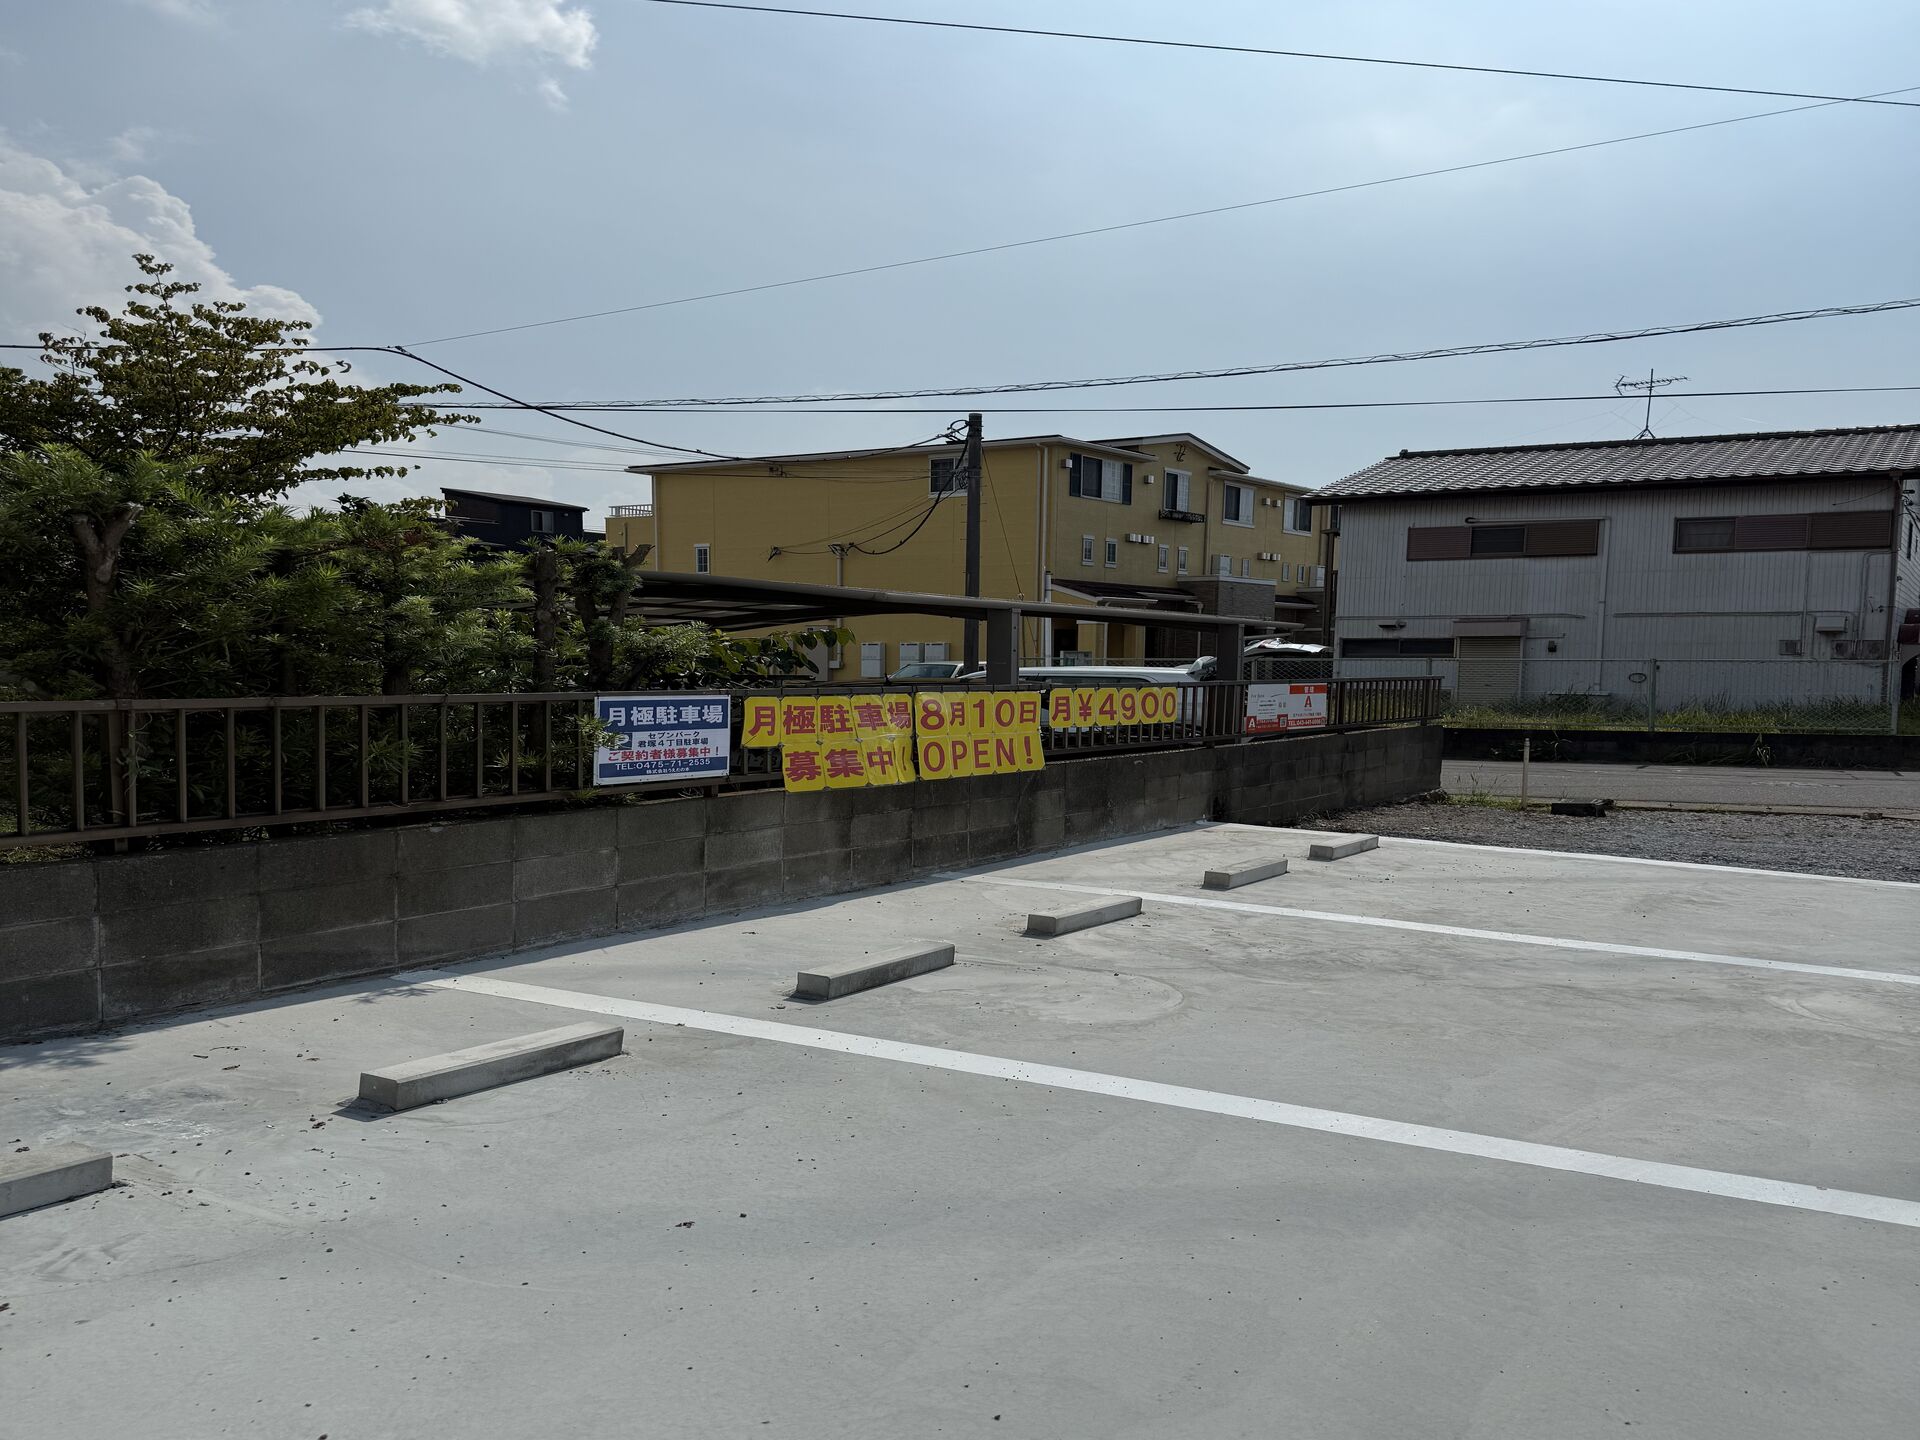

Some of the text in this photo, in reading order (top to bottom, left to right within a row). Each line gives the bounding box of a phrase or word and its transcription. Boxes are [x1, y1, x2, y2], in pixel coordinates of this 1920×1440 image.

[607, 705, 723, 727] 月極駐車場
[748, 701, 911, 737] 月極駐車場
[920, 699, 1037, 730] 8月10日
[1051, 692, 1176, 721] 月¥4900
[615, 758, 711, 771] TEL:0475-71-2535
[923, 736, 1034, 772] OPEN!
